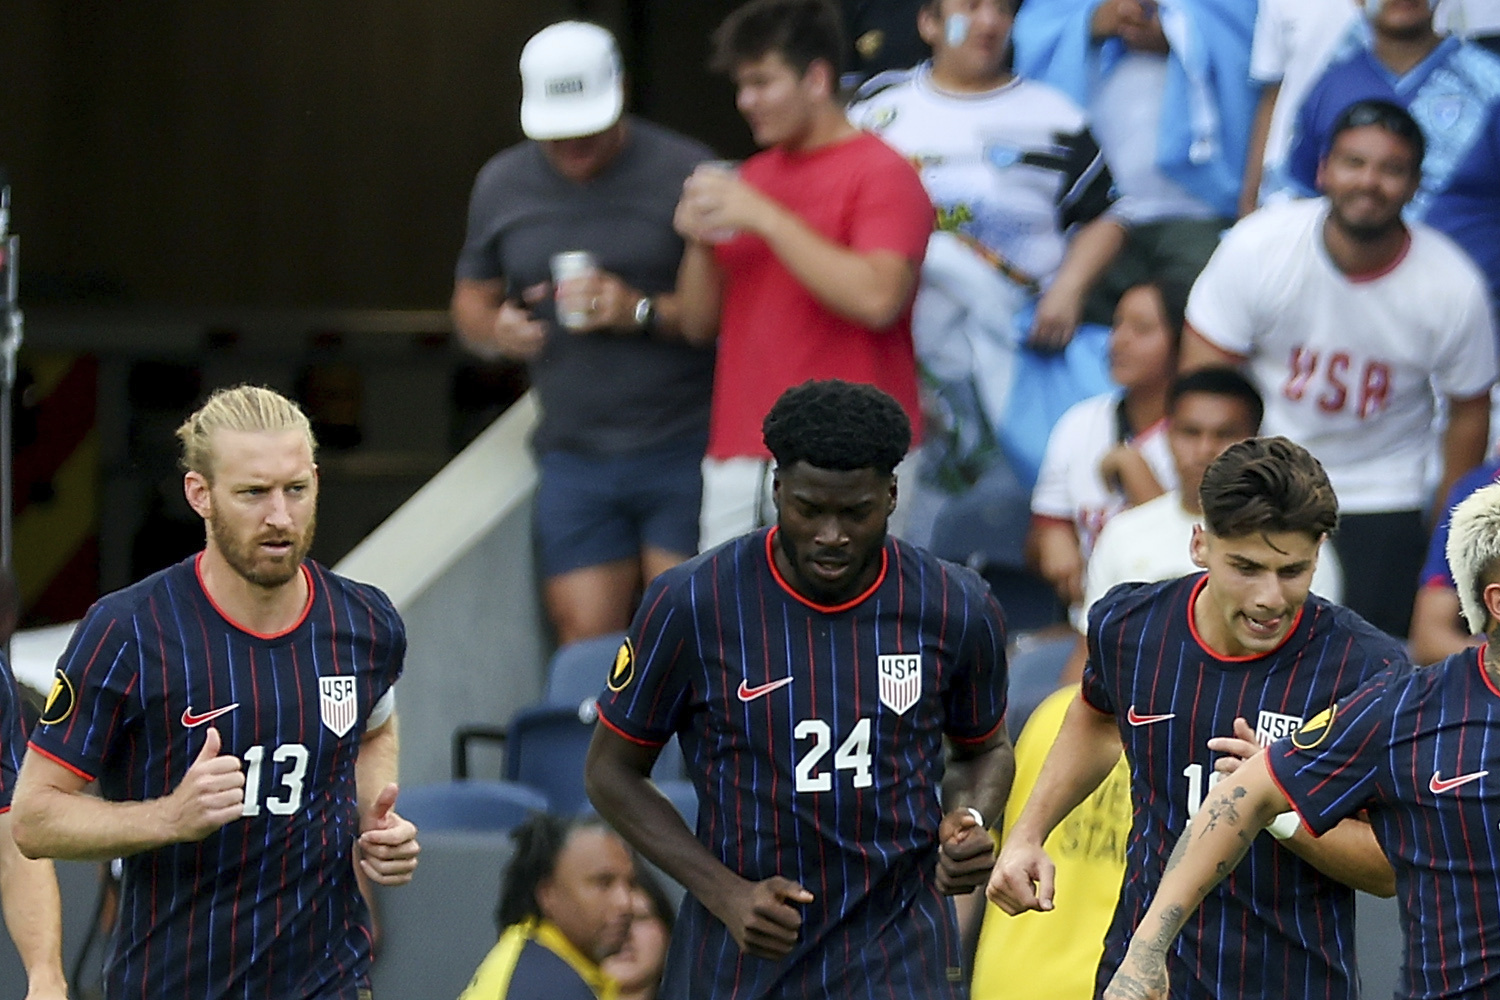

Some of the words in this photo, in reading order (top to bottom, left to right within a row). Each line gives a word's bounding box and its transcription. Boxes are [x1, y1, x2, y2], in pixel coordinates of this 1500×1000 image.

[1284, 345, 1391, 420] USA
[322, 680, 353, 702] USA
[879, 658, 918, 680] USA
[1260, 714, 1300, 739] USA
[241, 743, 309, 816] 13
[794, 718, 873, 792] 24
[1059, 817, 1128, 867] STA
